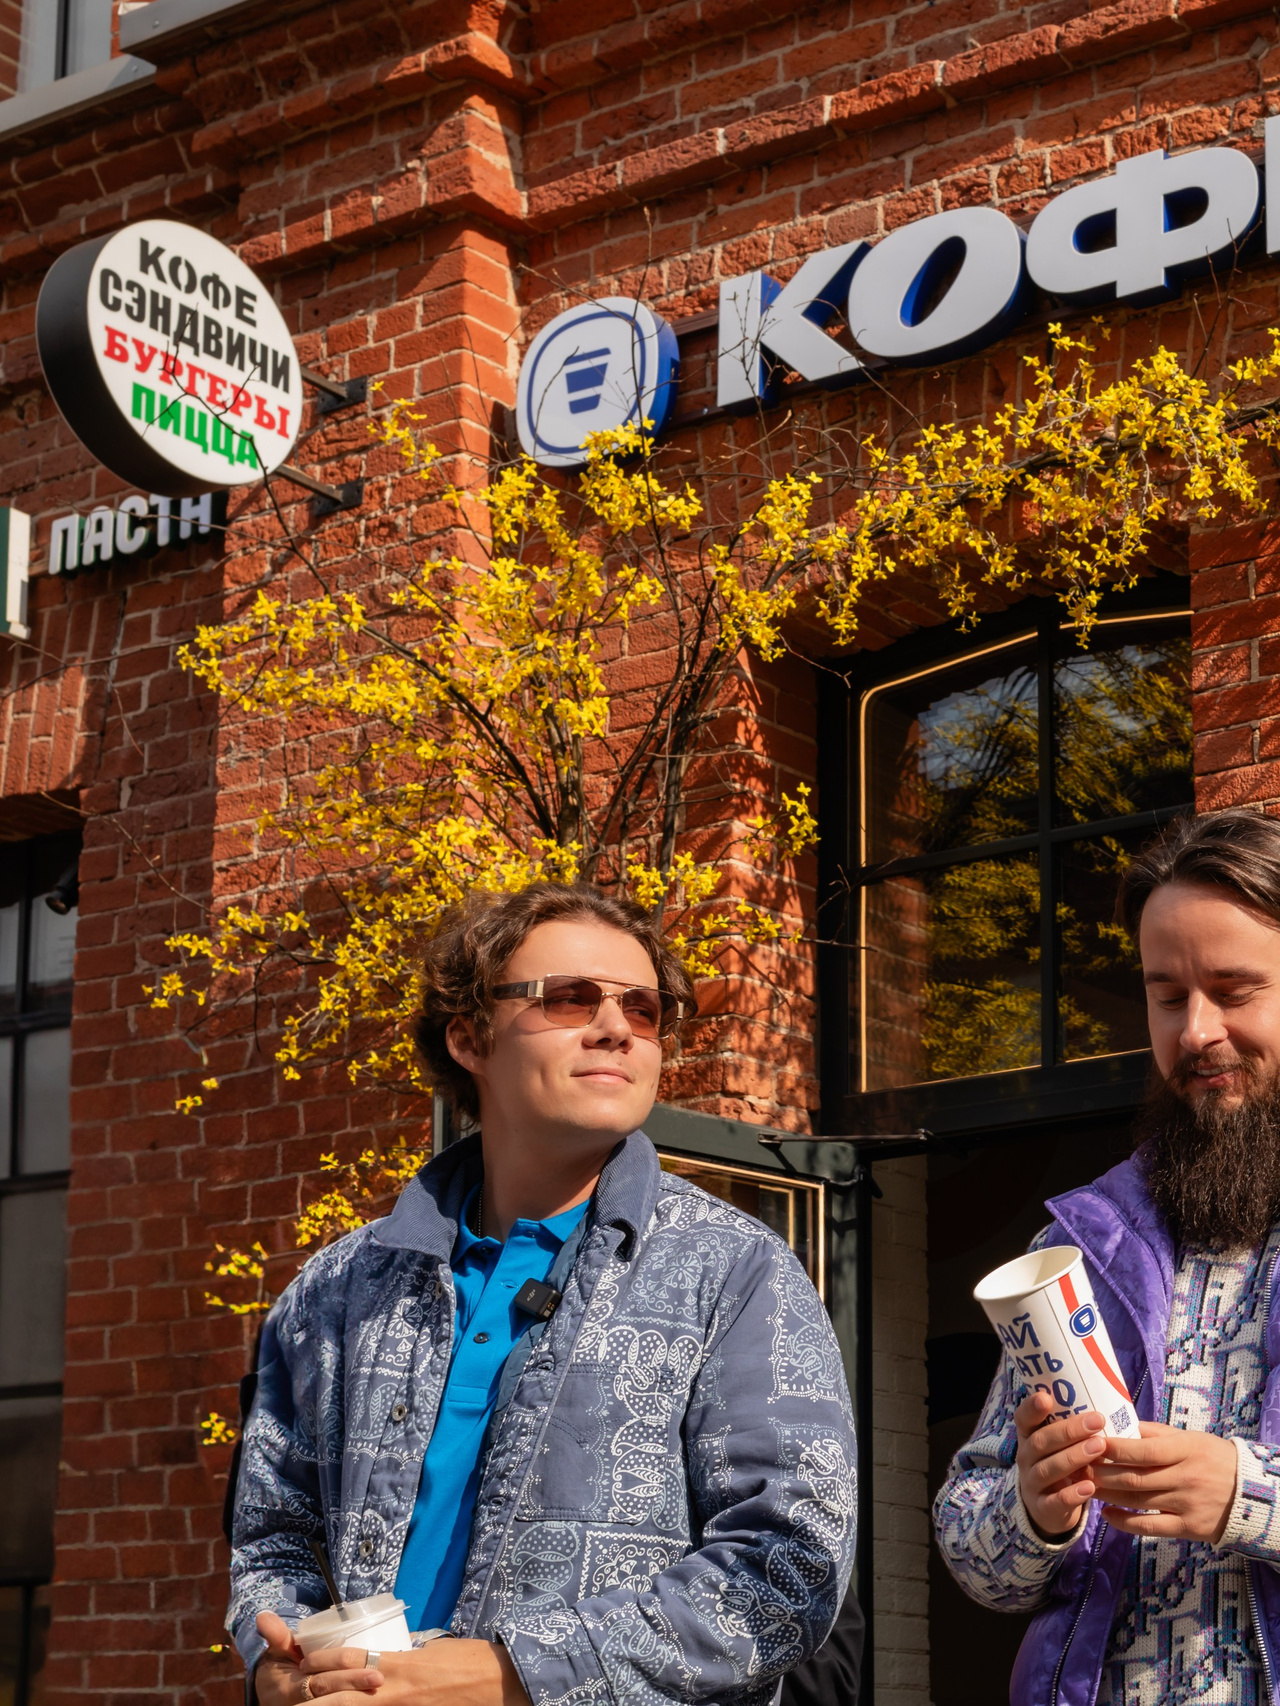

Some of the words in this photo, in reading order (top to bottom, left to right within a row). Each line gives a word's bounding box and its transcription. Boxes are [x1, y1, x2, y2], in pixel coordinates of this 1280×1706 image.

[139, 237, 258, 328] КОФЕ
[99, 267, 291, 394] СЭНДВИЧИ
[103, 325, 291, 439] БУРГЕРЫ
[131, 381, 260, 471] ПИЦЦА
[996, 1311, 1042, 1351] АЙ
